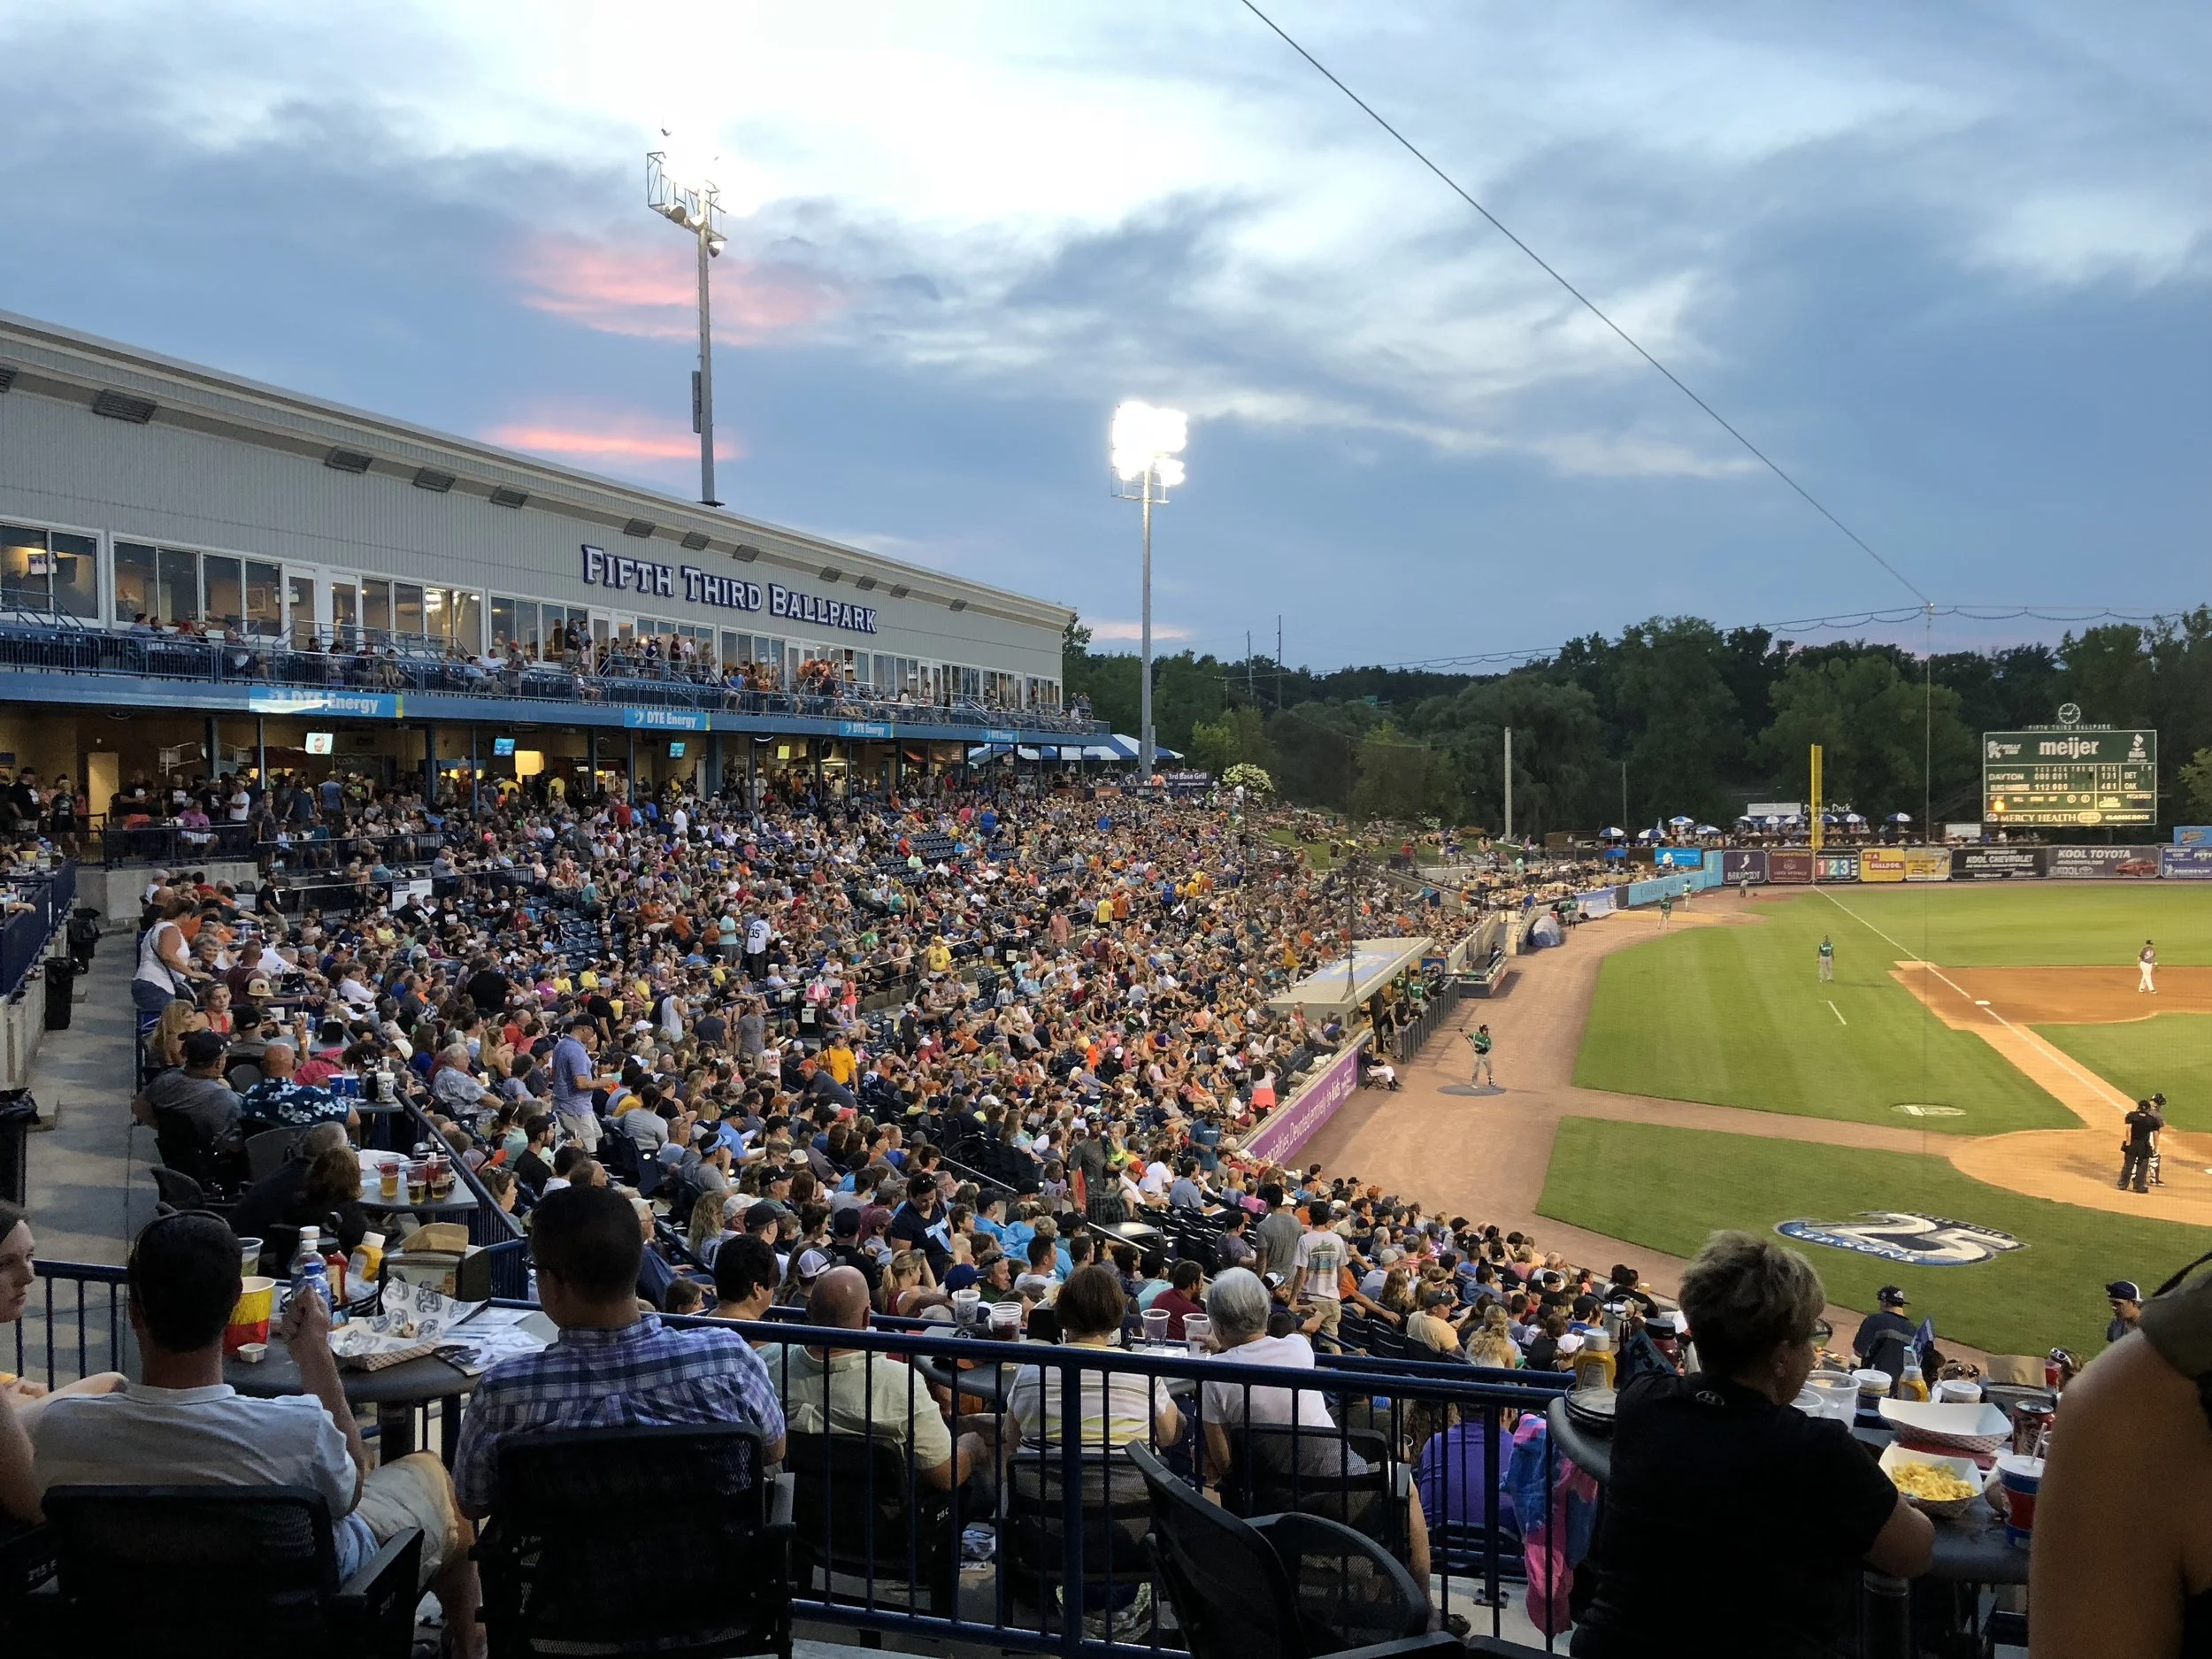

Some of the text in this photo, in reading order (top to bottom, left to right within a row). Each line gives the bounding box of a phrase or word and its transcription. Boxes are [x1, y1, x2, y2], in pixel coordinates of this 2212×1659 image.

[582, 544, 878, 634] FIFTH THIRD BALLPARK
[327, 693, 379, 715] Energy
[647, 710, 697, 729] DTE Energy
[2039, 736, 2099, 759] meijer
[1832, 803, 1853, 813] Deck
[2038, 813, 2077, 822] HEALTH
[1988, 855, 2034, 864] CHEVROLET
[2058, 849, 2131, 858] KOOL TOYOTA
[749, 928, 760, 939] 35
[1290, 1106, 1310, 1146] Devoted
[1310, 1094, 1327, 1125] entirely
